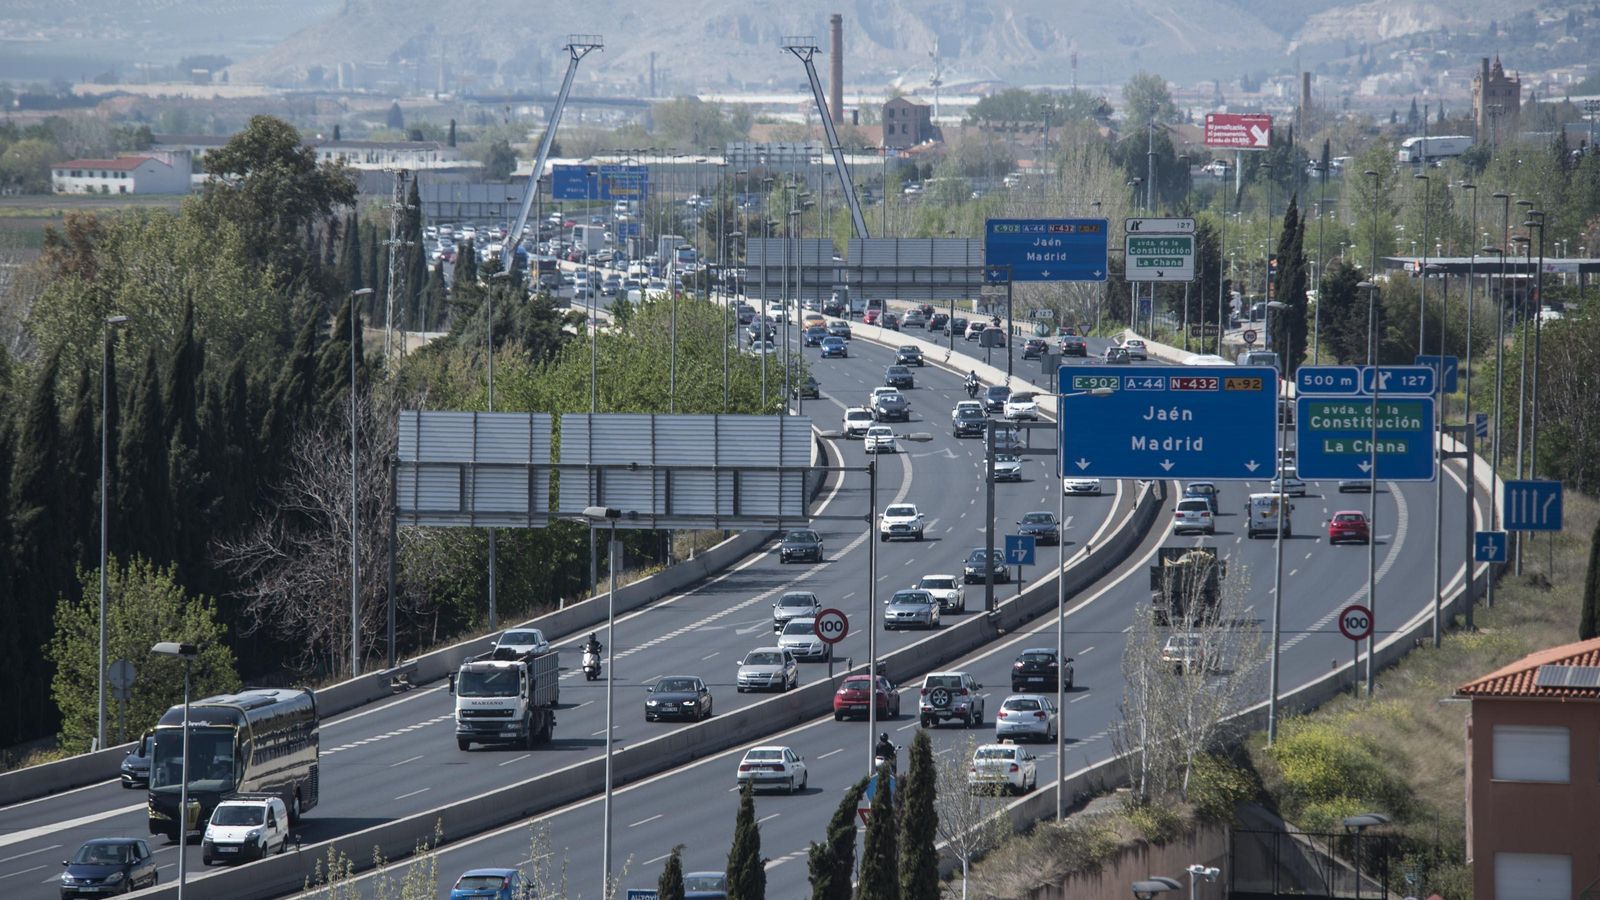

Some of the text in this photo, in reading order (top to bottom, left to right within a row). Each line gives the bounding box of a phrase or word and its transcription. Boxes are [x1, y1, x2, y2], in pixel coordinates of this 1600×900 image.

[1033, 237, 1062, 246] Jaén
[1026, 252, 1066, 261] Madrid
[1075, 379, 1261, 389] E-902 A-44 N-432 A-92
[1304, 376, 1352, 385] 500 m
[1402, 376, 1426, 386] 127
[1143, 405, 1193, 421] Jaén
[1323, 406, 1358, 414] avda.
[1387, 405, 1398, 414] la
[1311, 416, 1420, 428] Constitución
[1132, 436, 1204, 452] Madrid
[1325, 440, 1406, 452] La Chana
[820, 620, 843, 632] 100
[1345, 616, 1368, 629] 100
